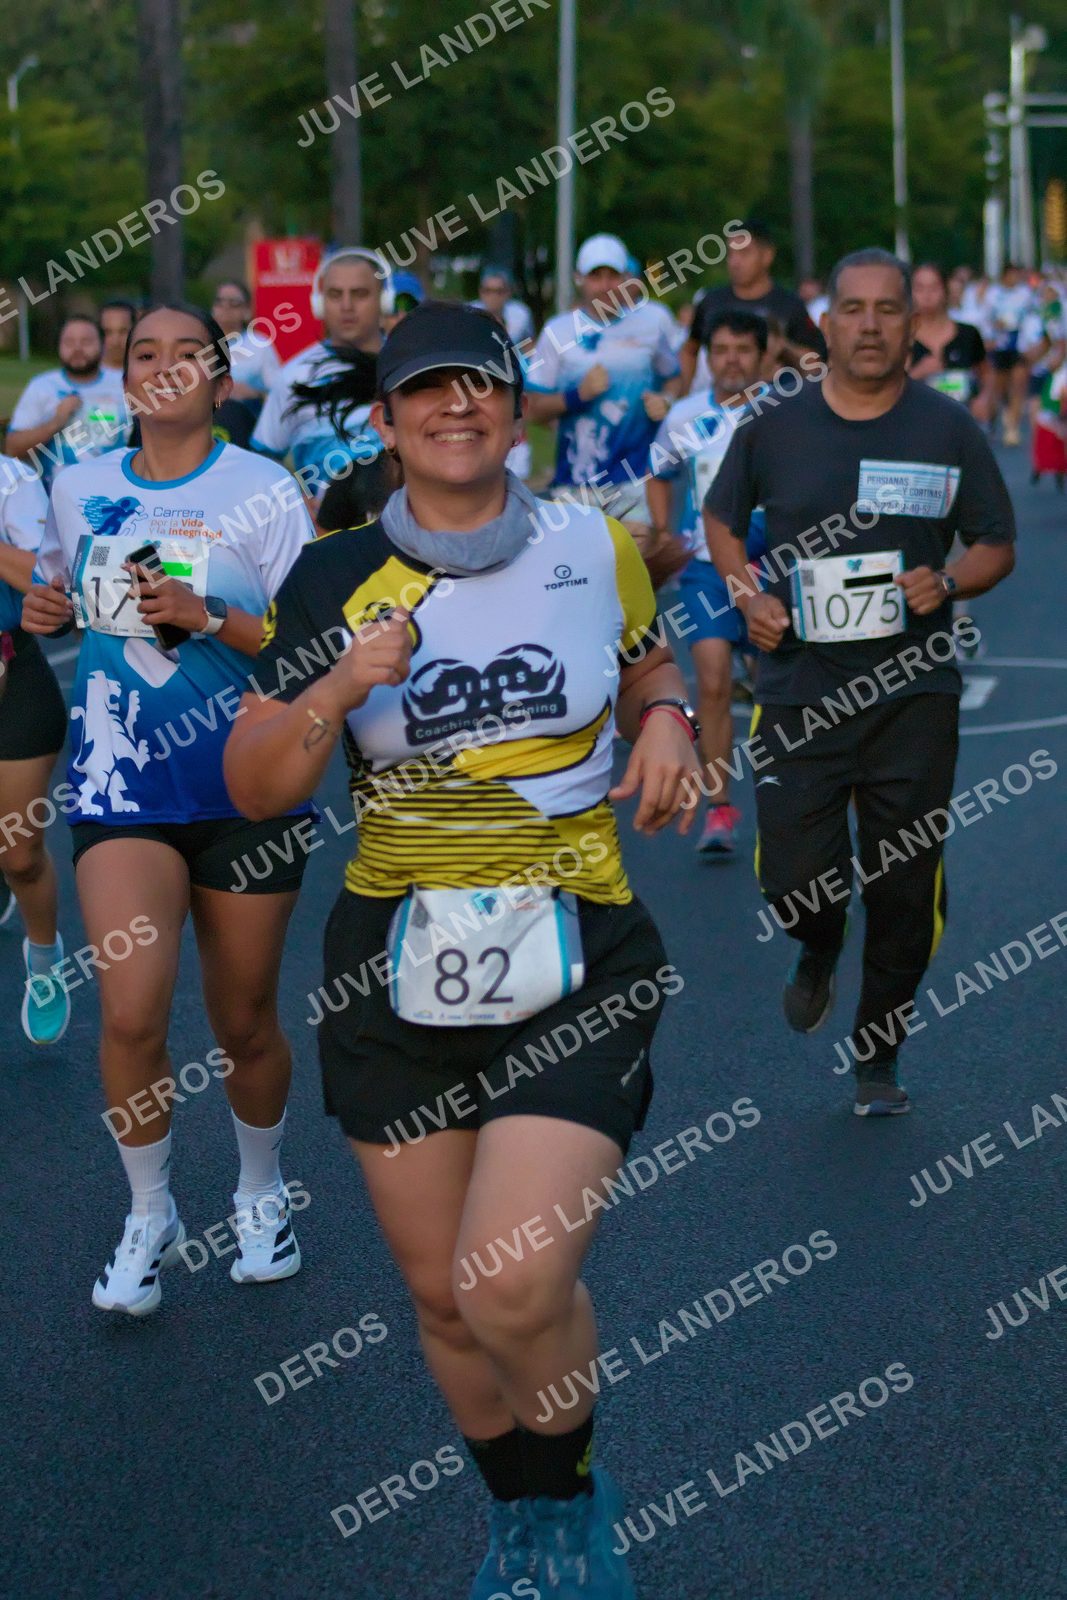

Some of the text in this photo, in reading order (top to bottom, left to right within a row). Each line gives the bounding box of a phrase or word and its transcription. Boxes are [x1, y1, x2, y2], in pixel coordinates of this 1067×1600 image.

[866, 475, 909, 486] PERSIANAS
[902, 487, 943, 498] Y CORTINAS
[153, 506, 205, 519] Carrera
[181, 518, 204, 527] Vida
[168, 527, 223, 540] Integridad
[543, 577, 589, 591] TOPTIME
[807, 588, 900, 630] 1075
[448, 671, 527, 697] RINOS
[415, 716, 480, 739] Coaching
[434, 946, 514, 1005] 82
